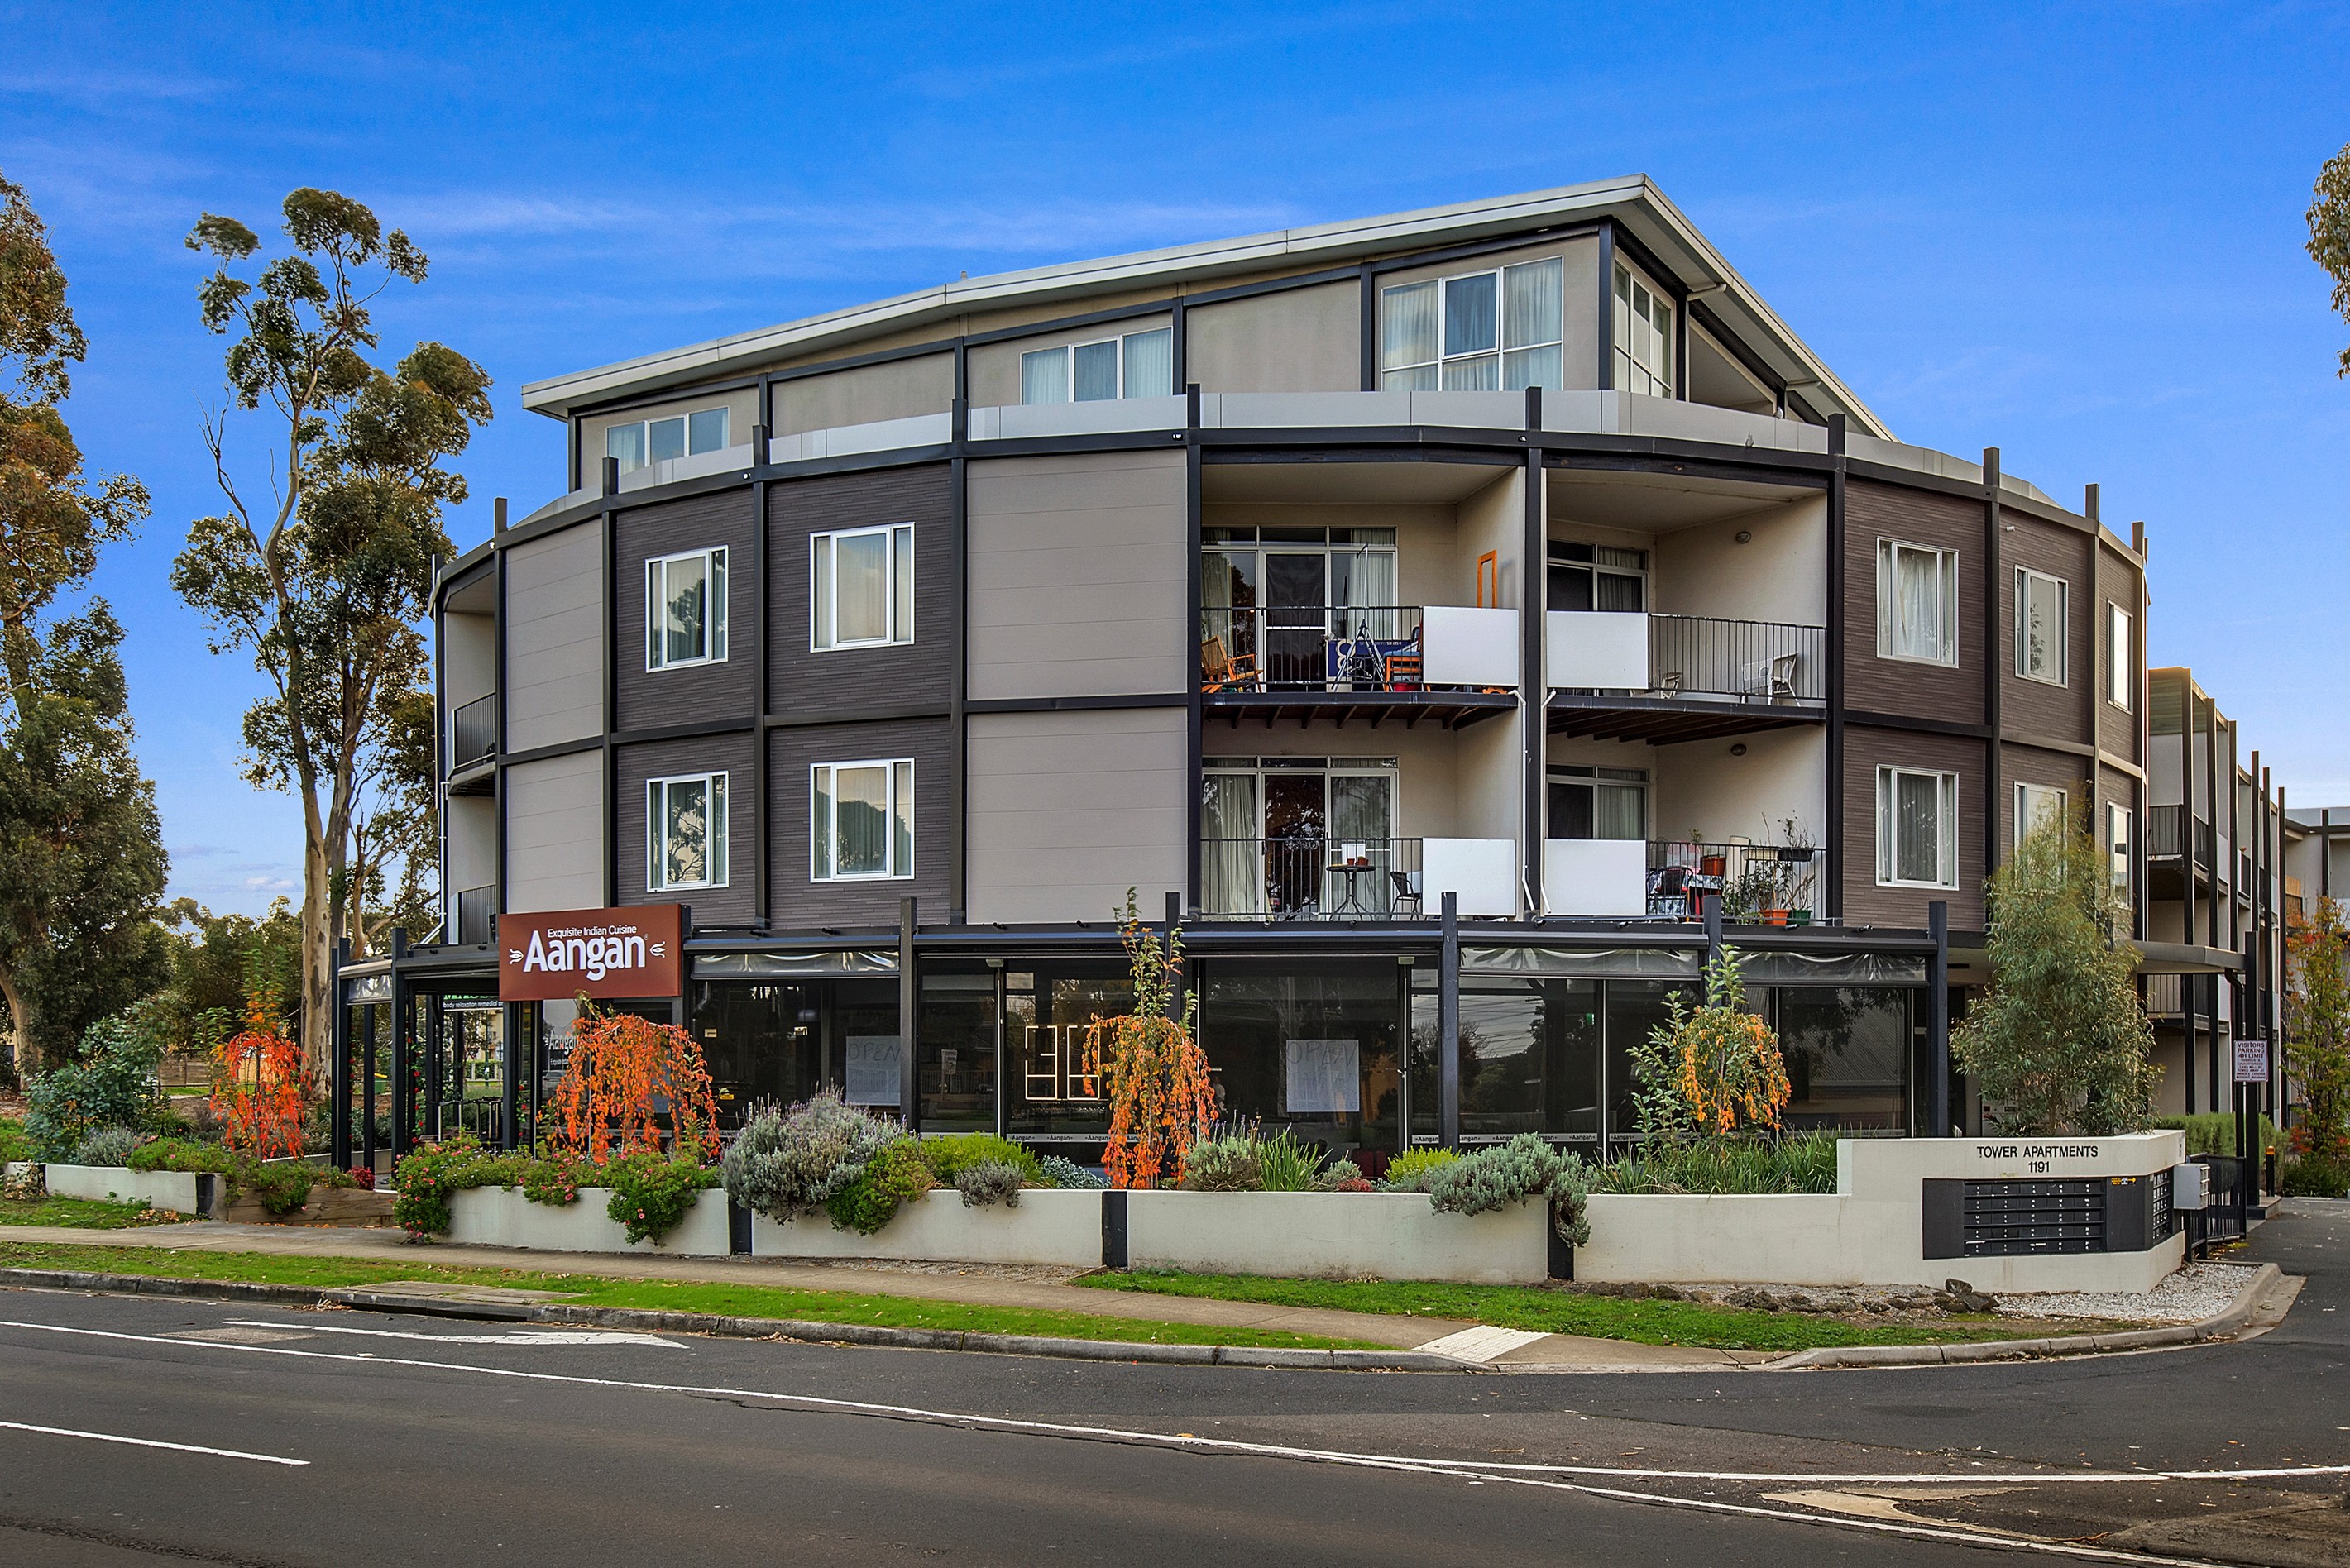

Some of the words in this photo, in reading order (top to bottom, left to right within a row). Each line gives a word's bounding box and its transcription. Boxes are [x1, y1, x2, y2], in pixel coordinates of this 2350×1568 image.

[548, 927, 582, 939] Exquisite
[583, 925, 607, 936] Indian
[609, 924, 637, 935] Cuisine
[523, 930, 646, 982] Aangan
[848, 1042, 901, 1062] OPEN
[1287, 1040, 1358, 1068] OPEN
[1976, 1145, 2017, 1158] TOWER
[2023, 1145, 2099, 1158] APARTMENTS
[2028, 1160, 2051, 1174] 1191
